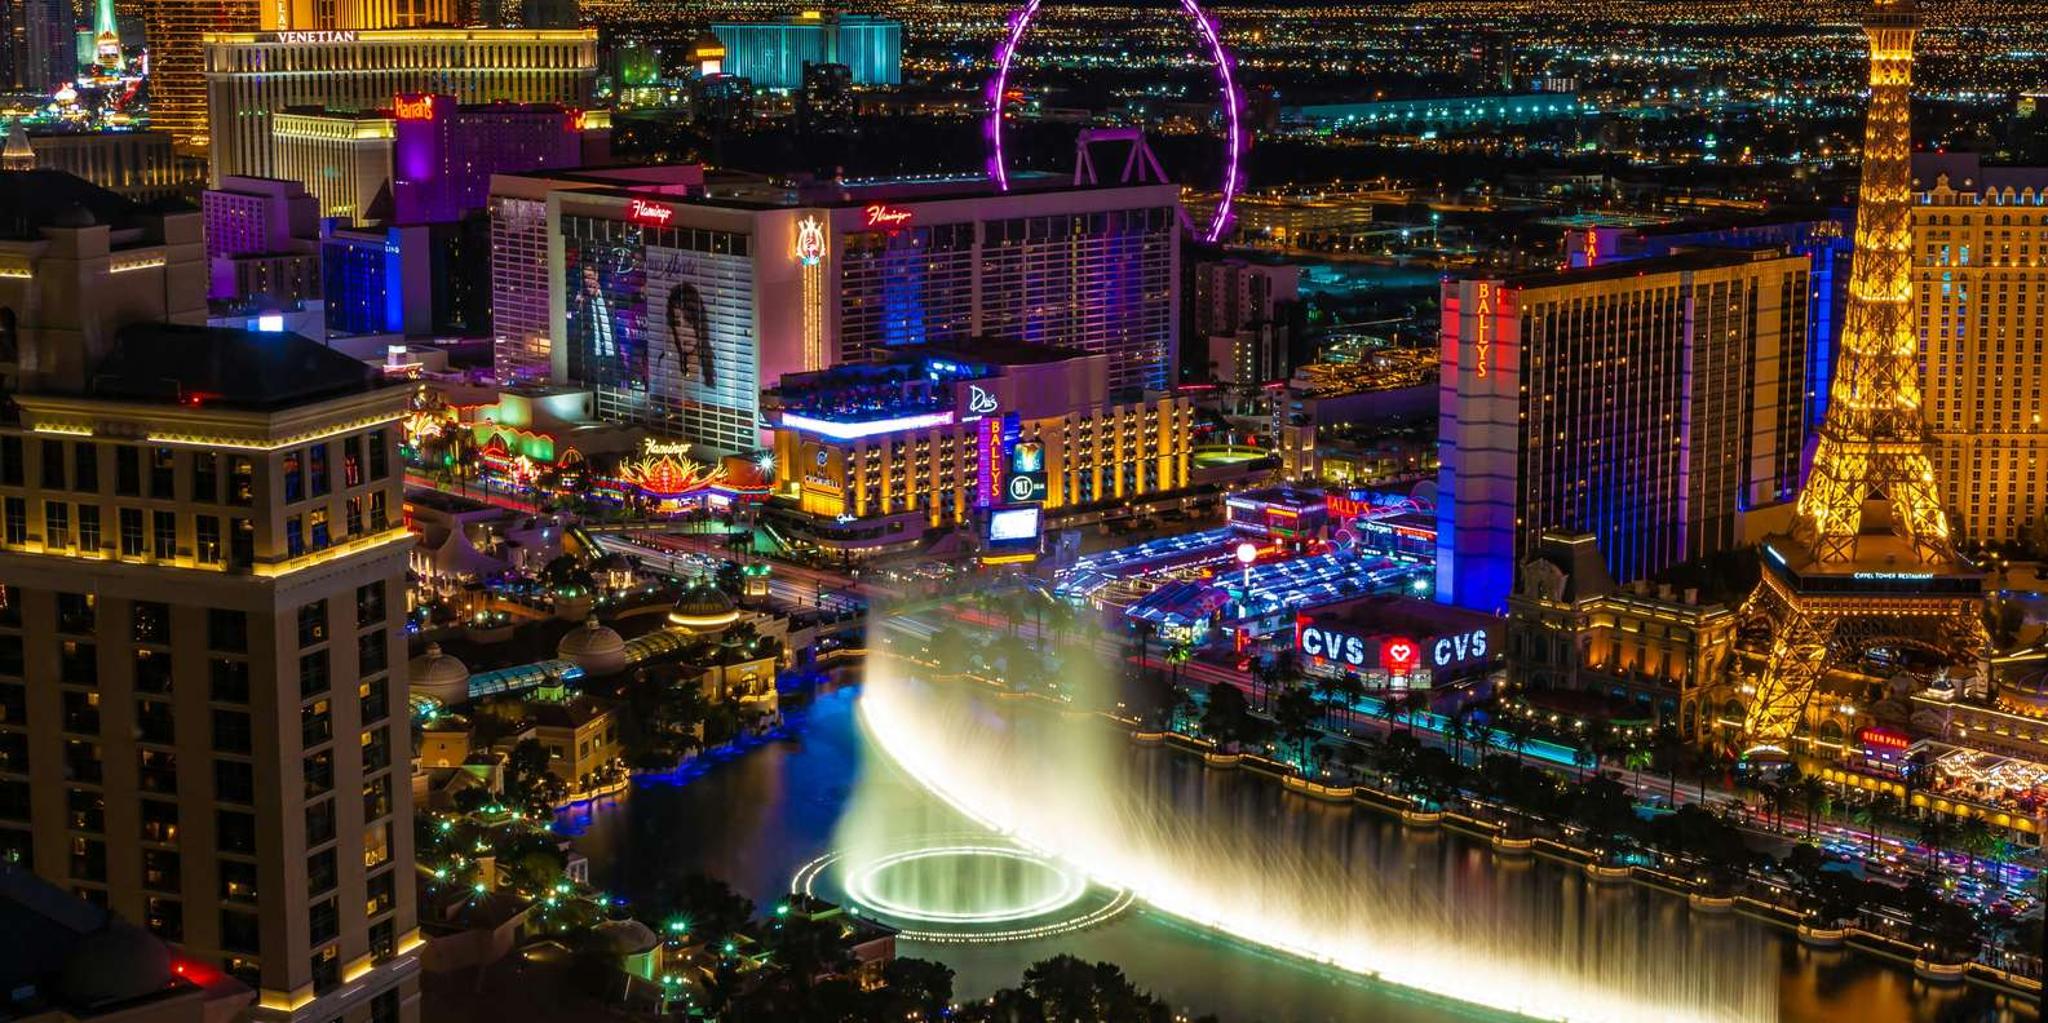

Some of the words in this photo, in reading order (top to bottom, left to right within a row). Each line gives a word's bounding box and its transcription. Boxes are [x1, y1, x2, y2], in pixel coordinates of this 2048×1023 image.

[278, 31, 354, 42] VENETIAN
[395, 96, 433, 120] Harrah's
[632, 199, 672, 224] Flamingo
[866, 205, 912, 225] Flamingo
[644, 437, 692, 459] Flamingo
[1015, 481, 1029, 495] BLT
[1854, 571, 1875, 580] EIFFEL
[1875, 572, 1896, 580] TOWER
[1302, 628, 1365, 665] CVS
[1434, 629, 1487, 666] CVS
[1863, 731, 1885, 744] BEER
[1886, 736, 1908, 749] PARK
